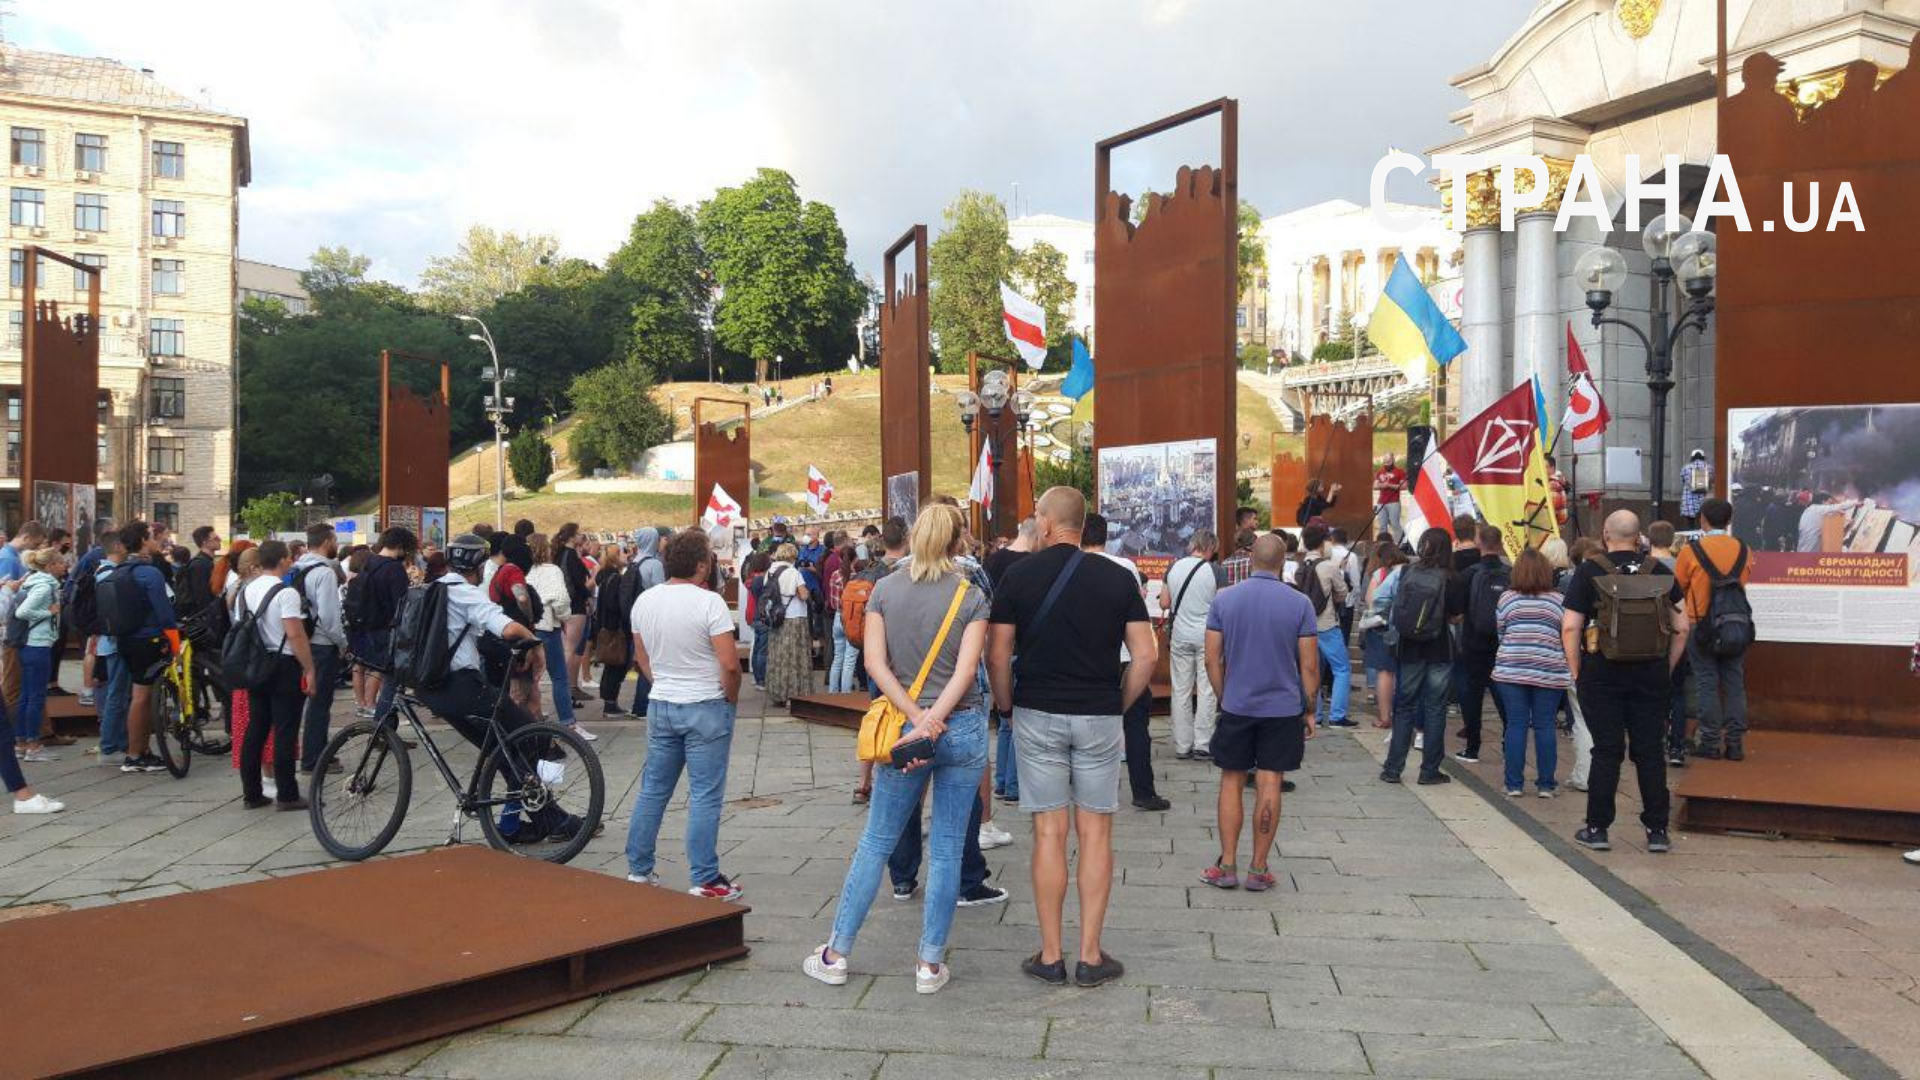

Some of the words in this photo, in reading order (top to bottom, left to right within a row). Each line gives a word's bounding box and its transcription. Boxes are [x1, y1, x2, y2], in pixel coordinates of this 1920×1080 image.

[1819, 556, 1895, 567] ЄВРОМАЙДАН
[1787, 567, 1851, 577] РЕВОЛЮЦІЯ
[1853, 568, 1903, 578] ГІДНОСТІ
